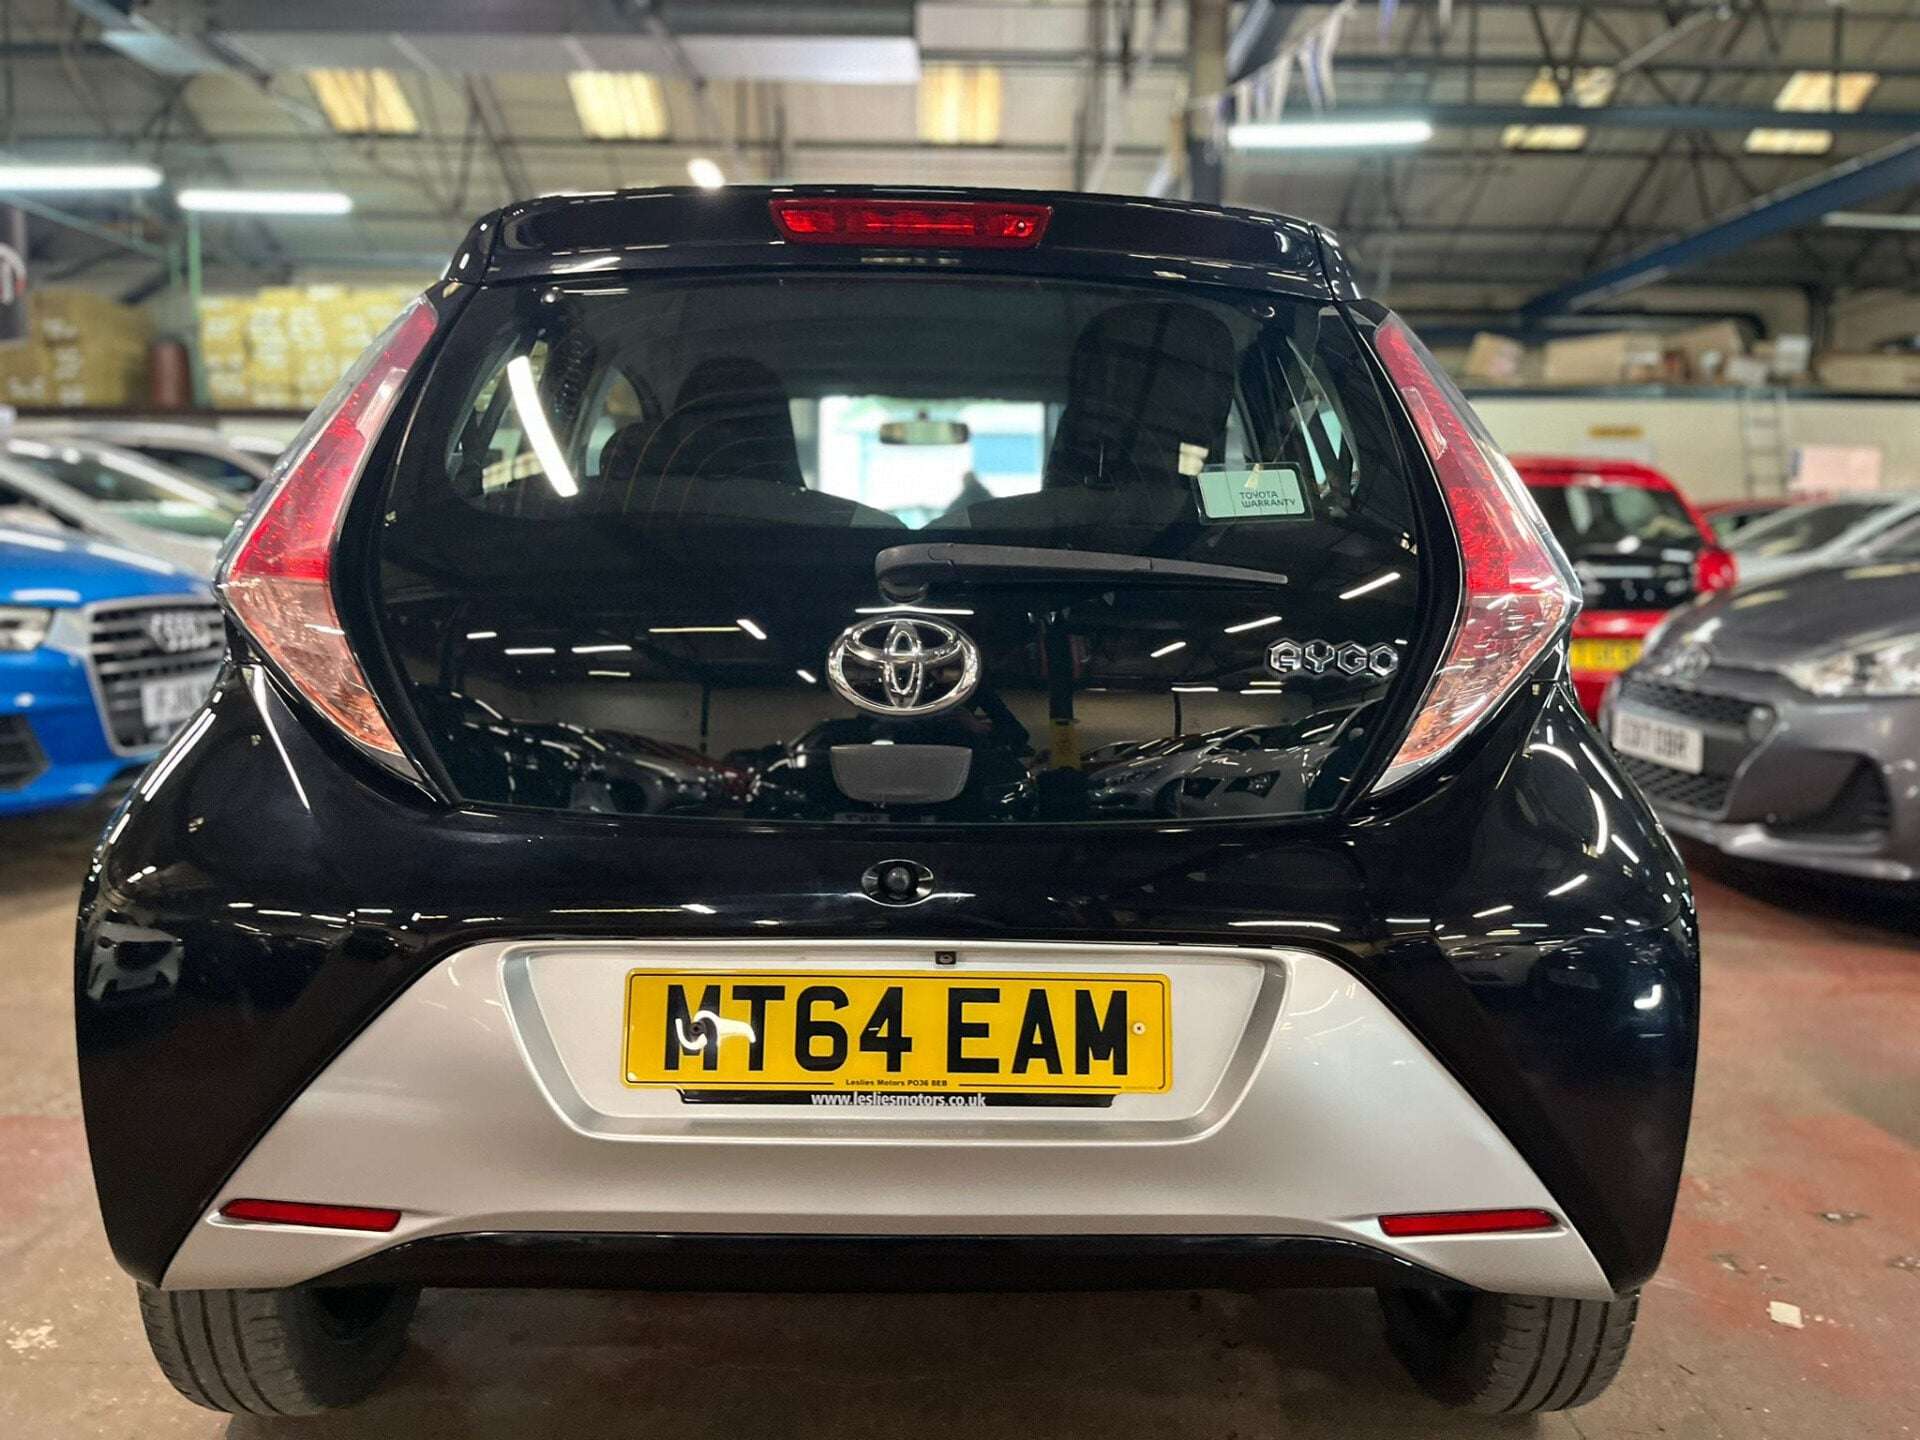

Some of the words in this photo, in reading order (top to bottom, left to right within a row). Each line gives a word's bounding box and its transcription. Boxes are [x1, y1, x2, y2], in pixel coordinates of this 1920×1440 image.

[1240, 491, 1279, 500] TOYOTA
[1240, 498, 1296, 508] WARRANTY
[1267, 639, 1399, 678] AYGO
[663, 984, 913, 1073] MT64
[946, 987, 1128, 1076] EAM
[845, 1079, 875, 1087] Leslies
[877, 1079, 905, 1087] Motors
[907, 1079, 929, 1087] PO36
[811, 1091, 987, 1107] www.lesliesmotors.co.uk
